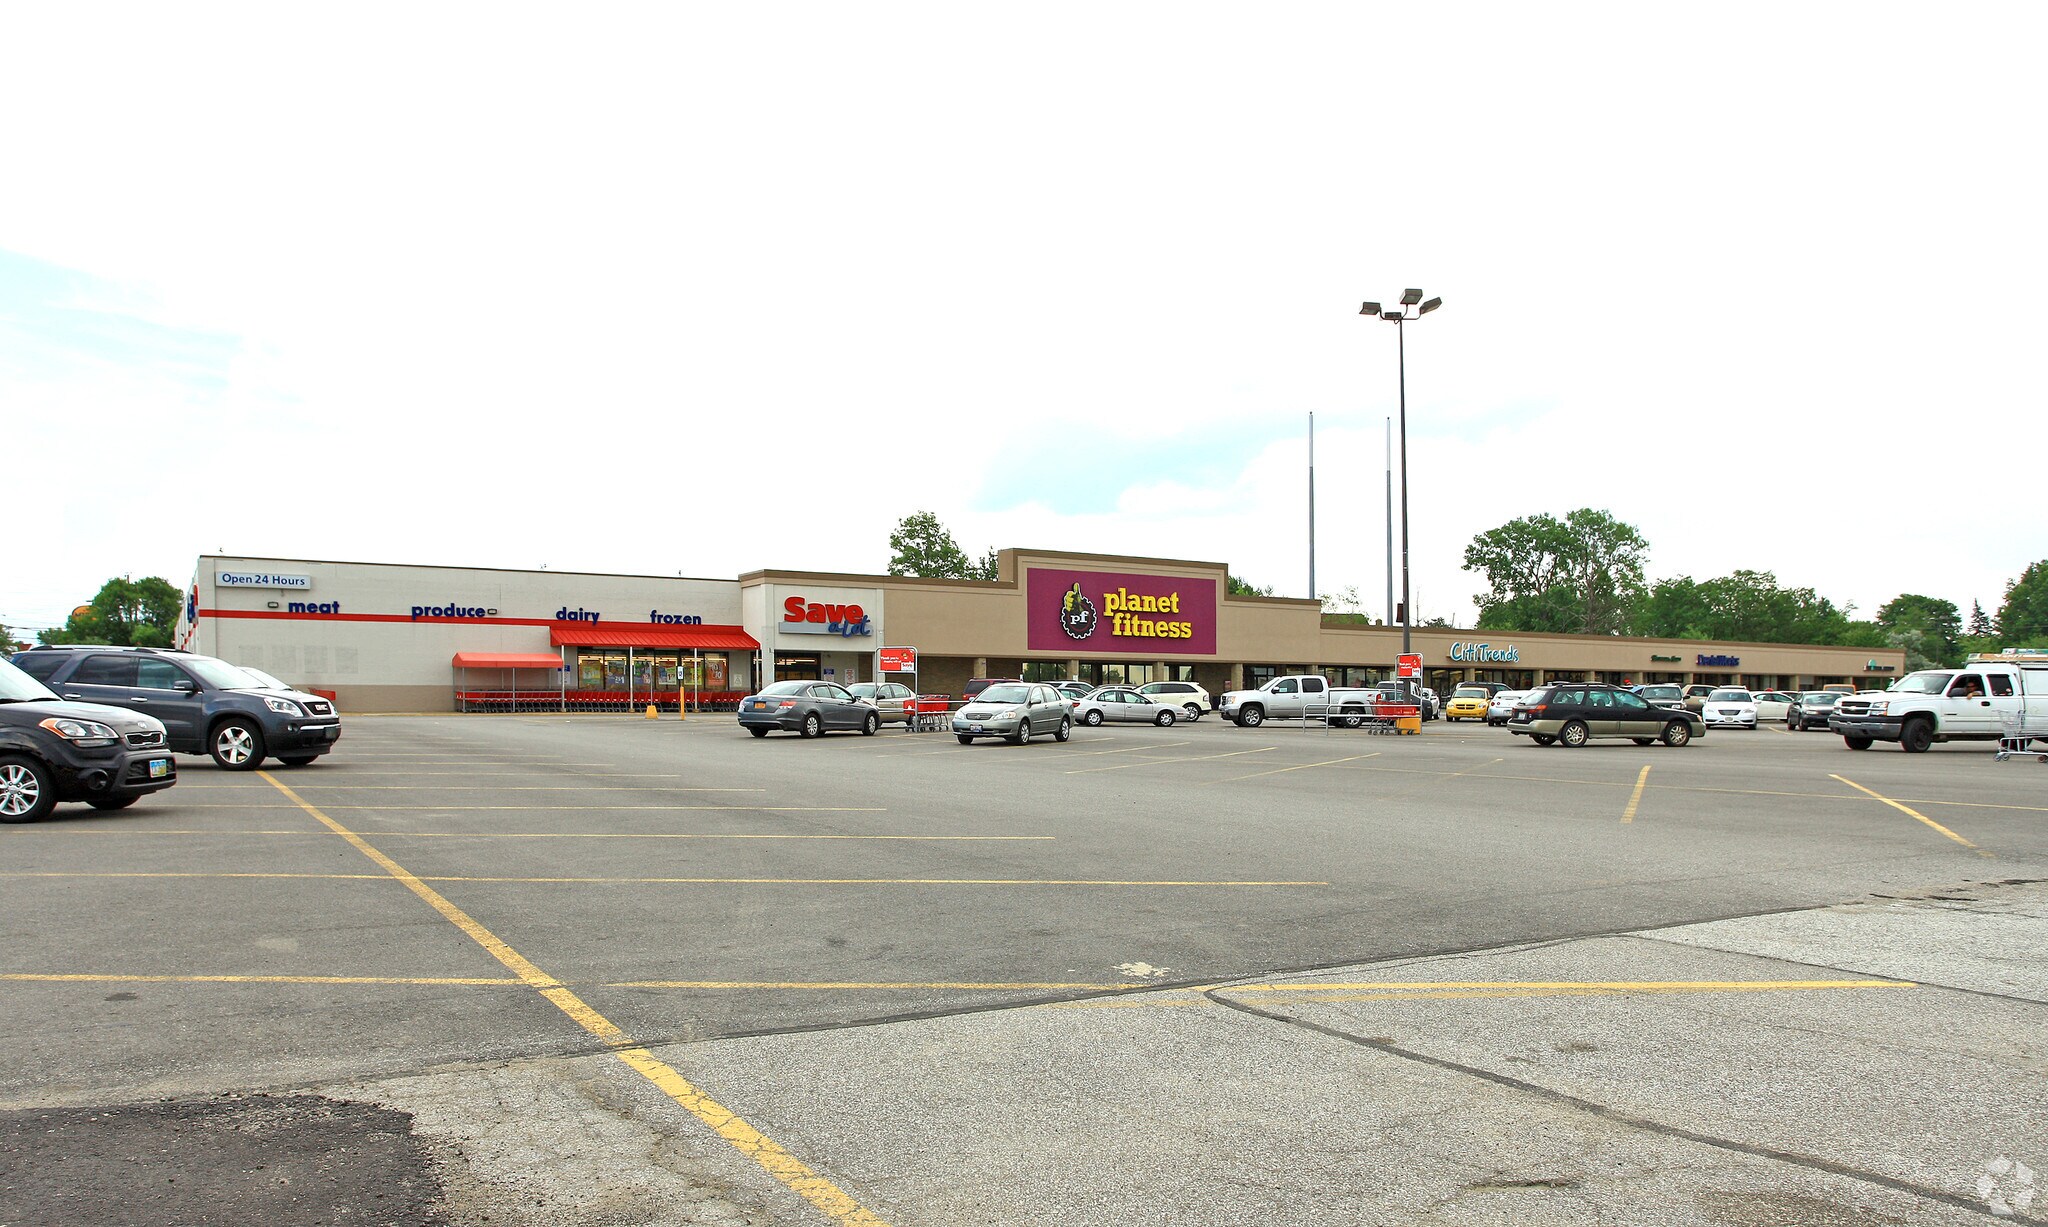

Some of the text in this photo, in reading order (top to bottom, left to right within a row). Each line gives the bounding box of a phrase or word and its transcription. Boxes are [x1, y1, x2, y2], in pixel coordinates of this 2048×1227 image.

[222, 573, 305, 586] Open 24 Hours
[288, 601, 340, 614] meat
[411, 602, 486, 620] produce
[783, 595, 864, 624] Save
[1103, 587, 1180, 617] planet
[555, 606, 600, 626] dairy
[650, 609, 702, 625] frozen
[1070, 610, 1089, 625] pf
[1112, 612, 1193, 639] fitness
